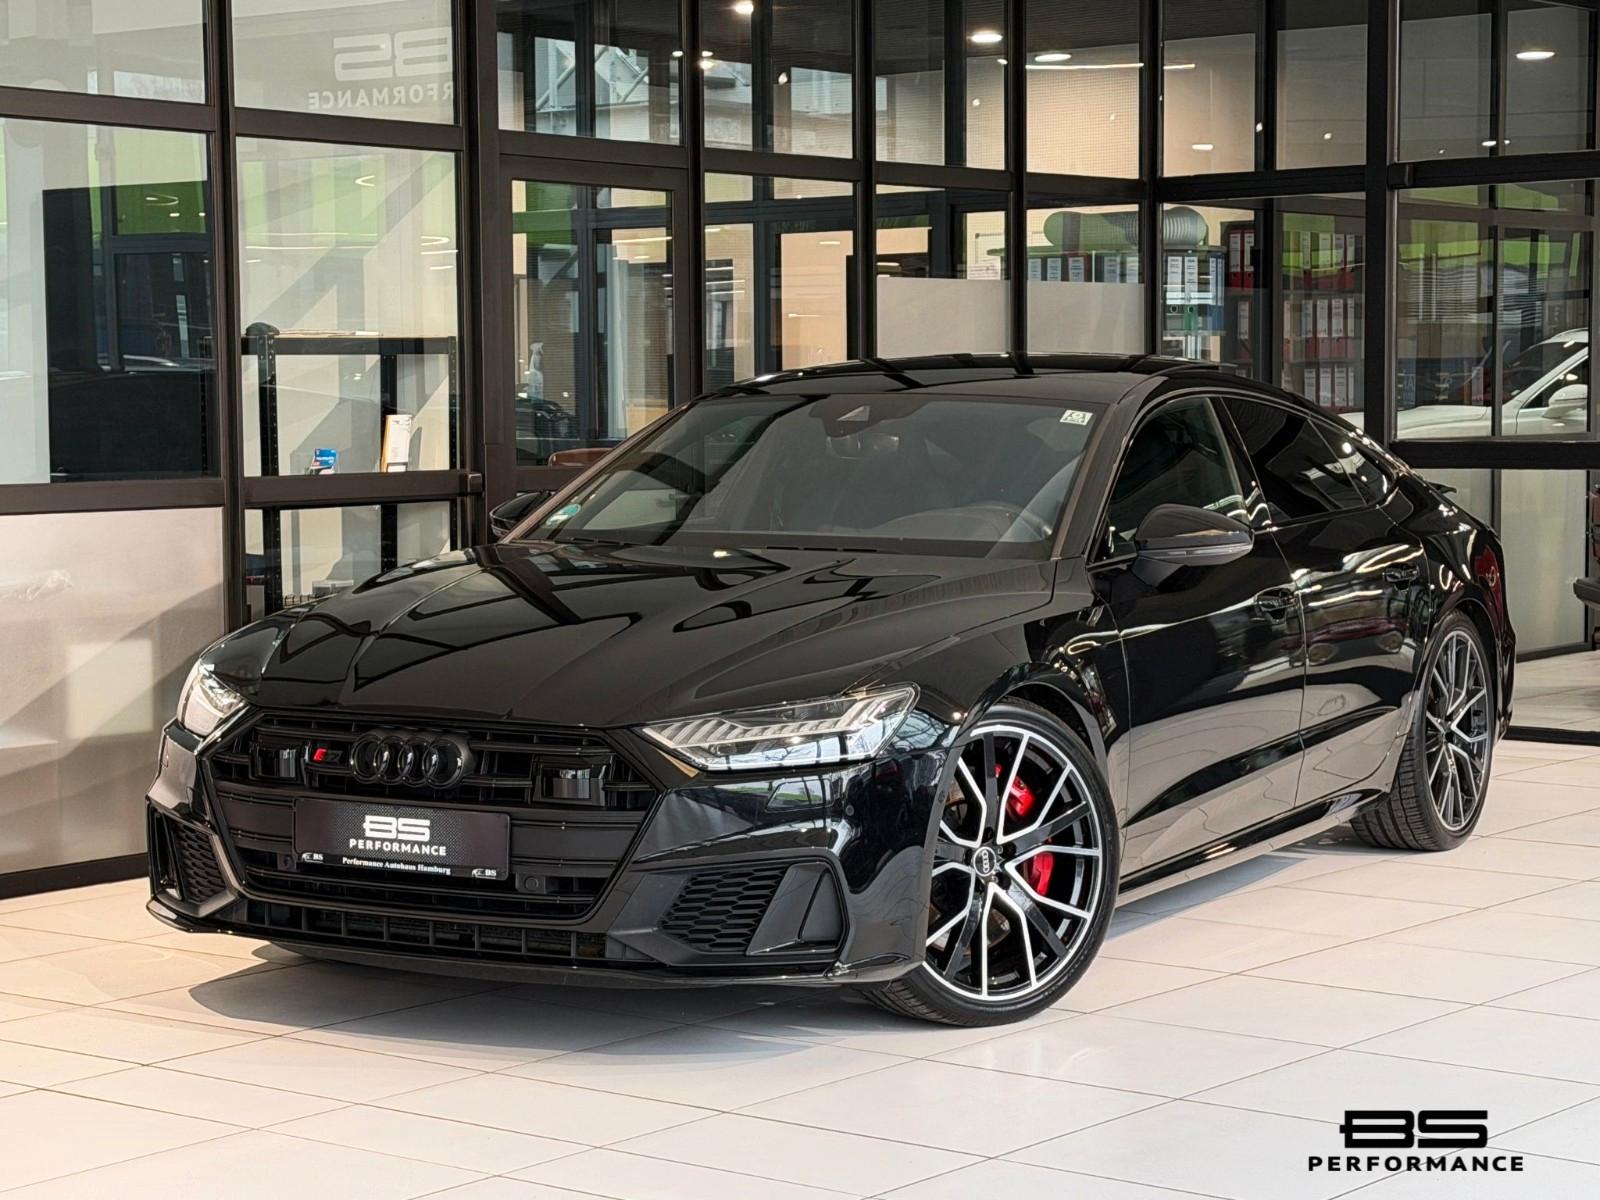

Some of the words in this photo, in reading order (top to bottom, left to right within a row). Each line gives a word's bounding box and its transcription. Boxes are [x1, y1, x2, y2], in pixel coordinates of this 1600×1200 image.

[363, 815, 430, 842] BS
[349, 838, 447, 856] PERFORMANCE
[342, 857, 384, 868] Performance
[417, 864, 451, 875] Hamburg
